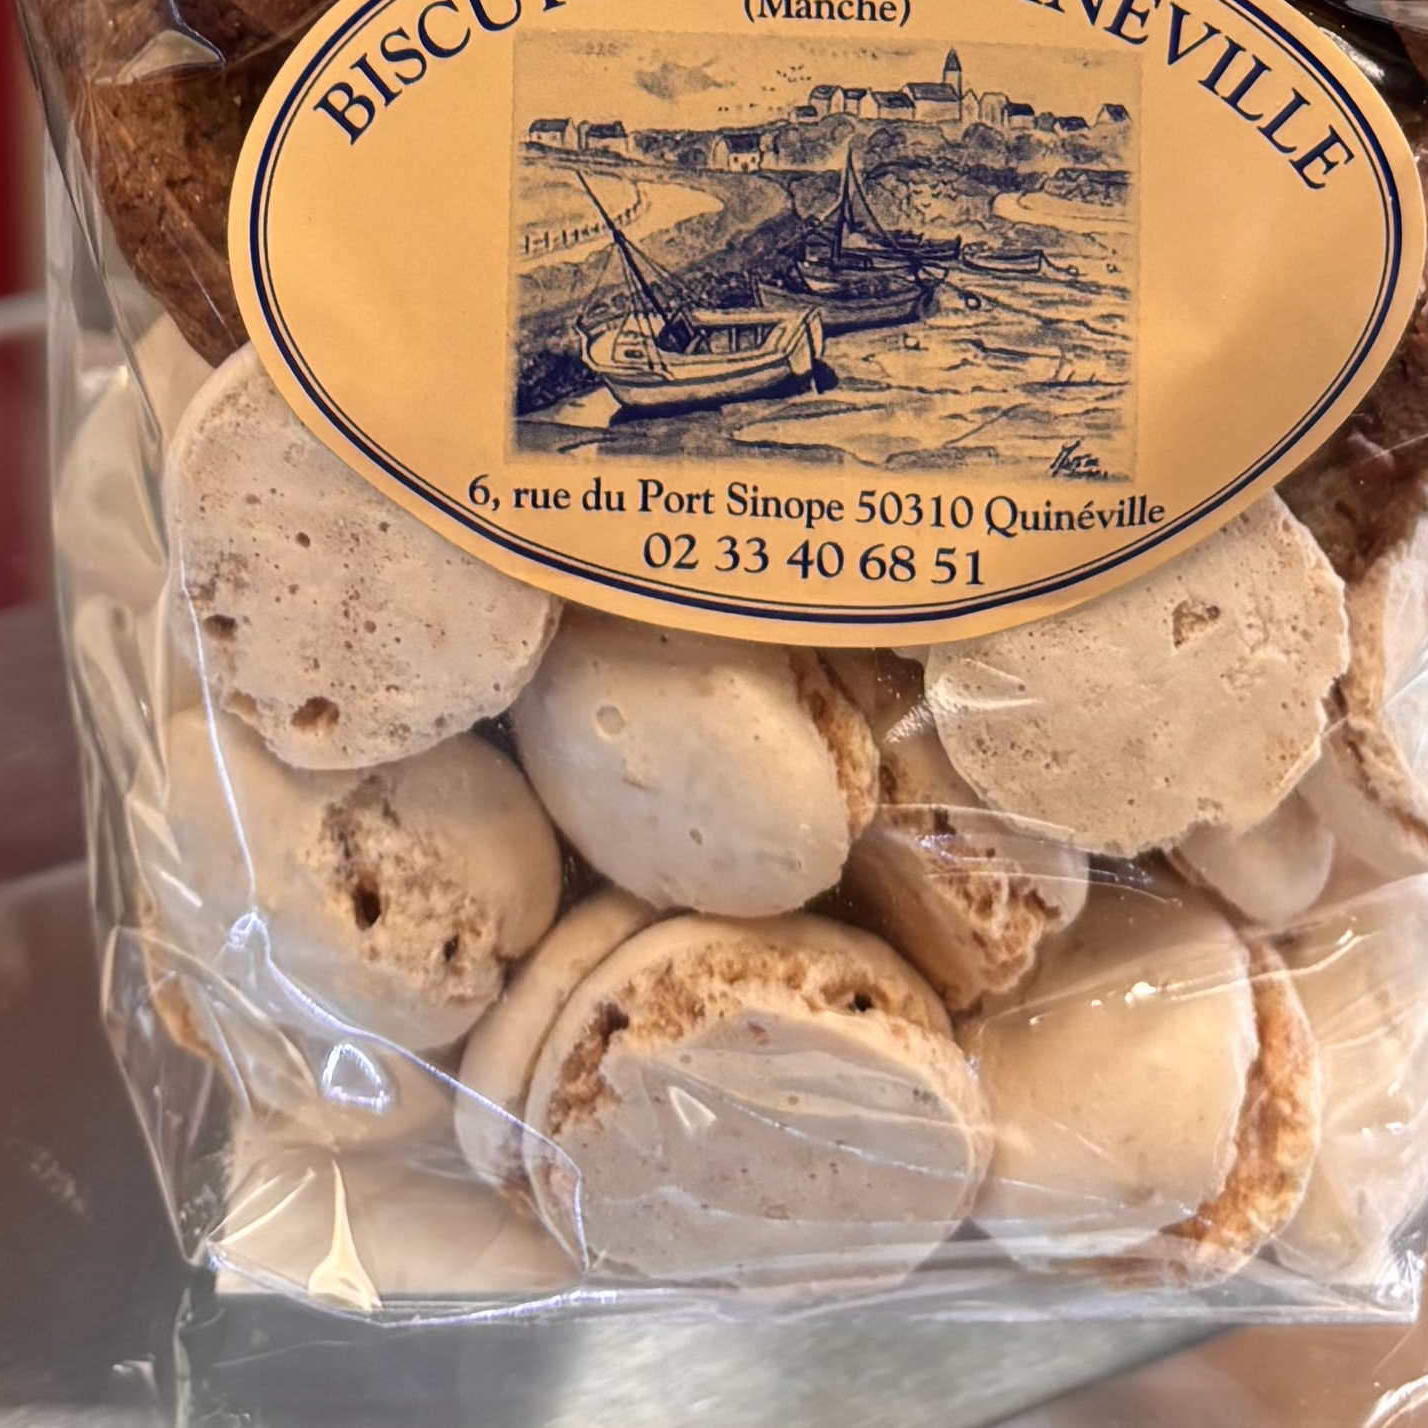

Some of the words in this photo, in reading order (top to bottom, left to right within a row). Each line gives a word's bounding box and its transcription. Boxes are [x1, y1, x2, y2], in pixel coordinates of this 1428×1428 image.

[467, 473, 502, 513] 6,
[512, 485, 572, 510] rue
[581, 476, 628, 513] du
[637, 477, 716, 515] Port
[725, 481, 845, 529] Sinope
[854, 489, 974, 529] 50310
[984, 494, 1166, 538] Quinéville
[642, 531, 700, 571] 02
[714, 534, 770, 574] 33
[785, 538, 845, 580] 40
[858, 543, 917, 584] 68
[929, 546, 986, 587] 51
